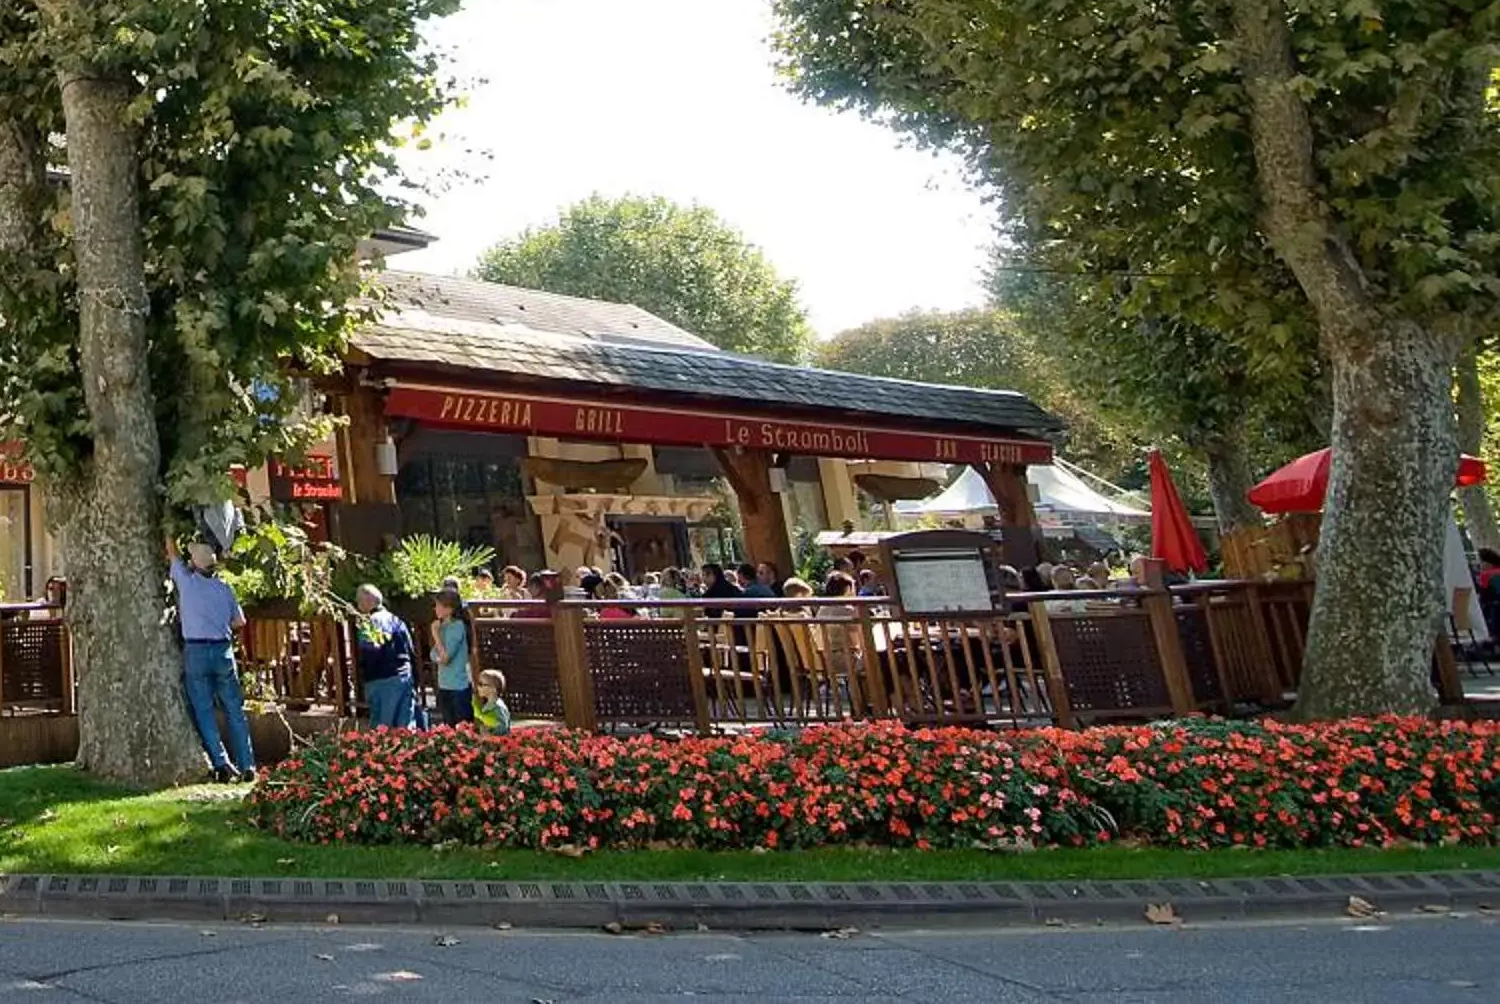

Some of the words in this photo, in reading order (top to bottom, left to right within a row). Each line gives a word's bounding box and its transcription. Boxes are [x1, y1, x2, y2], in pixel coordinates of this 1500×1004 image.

[439, 396, 532, 427] PIZZERIA
[575, 407, 624, 433] GRILL
[725, 419, 749, 444] Le
[760, 423, 870, 453] Stromboli
